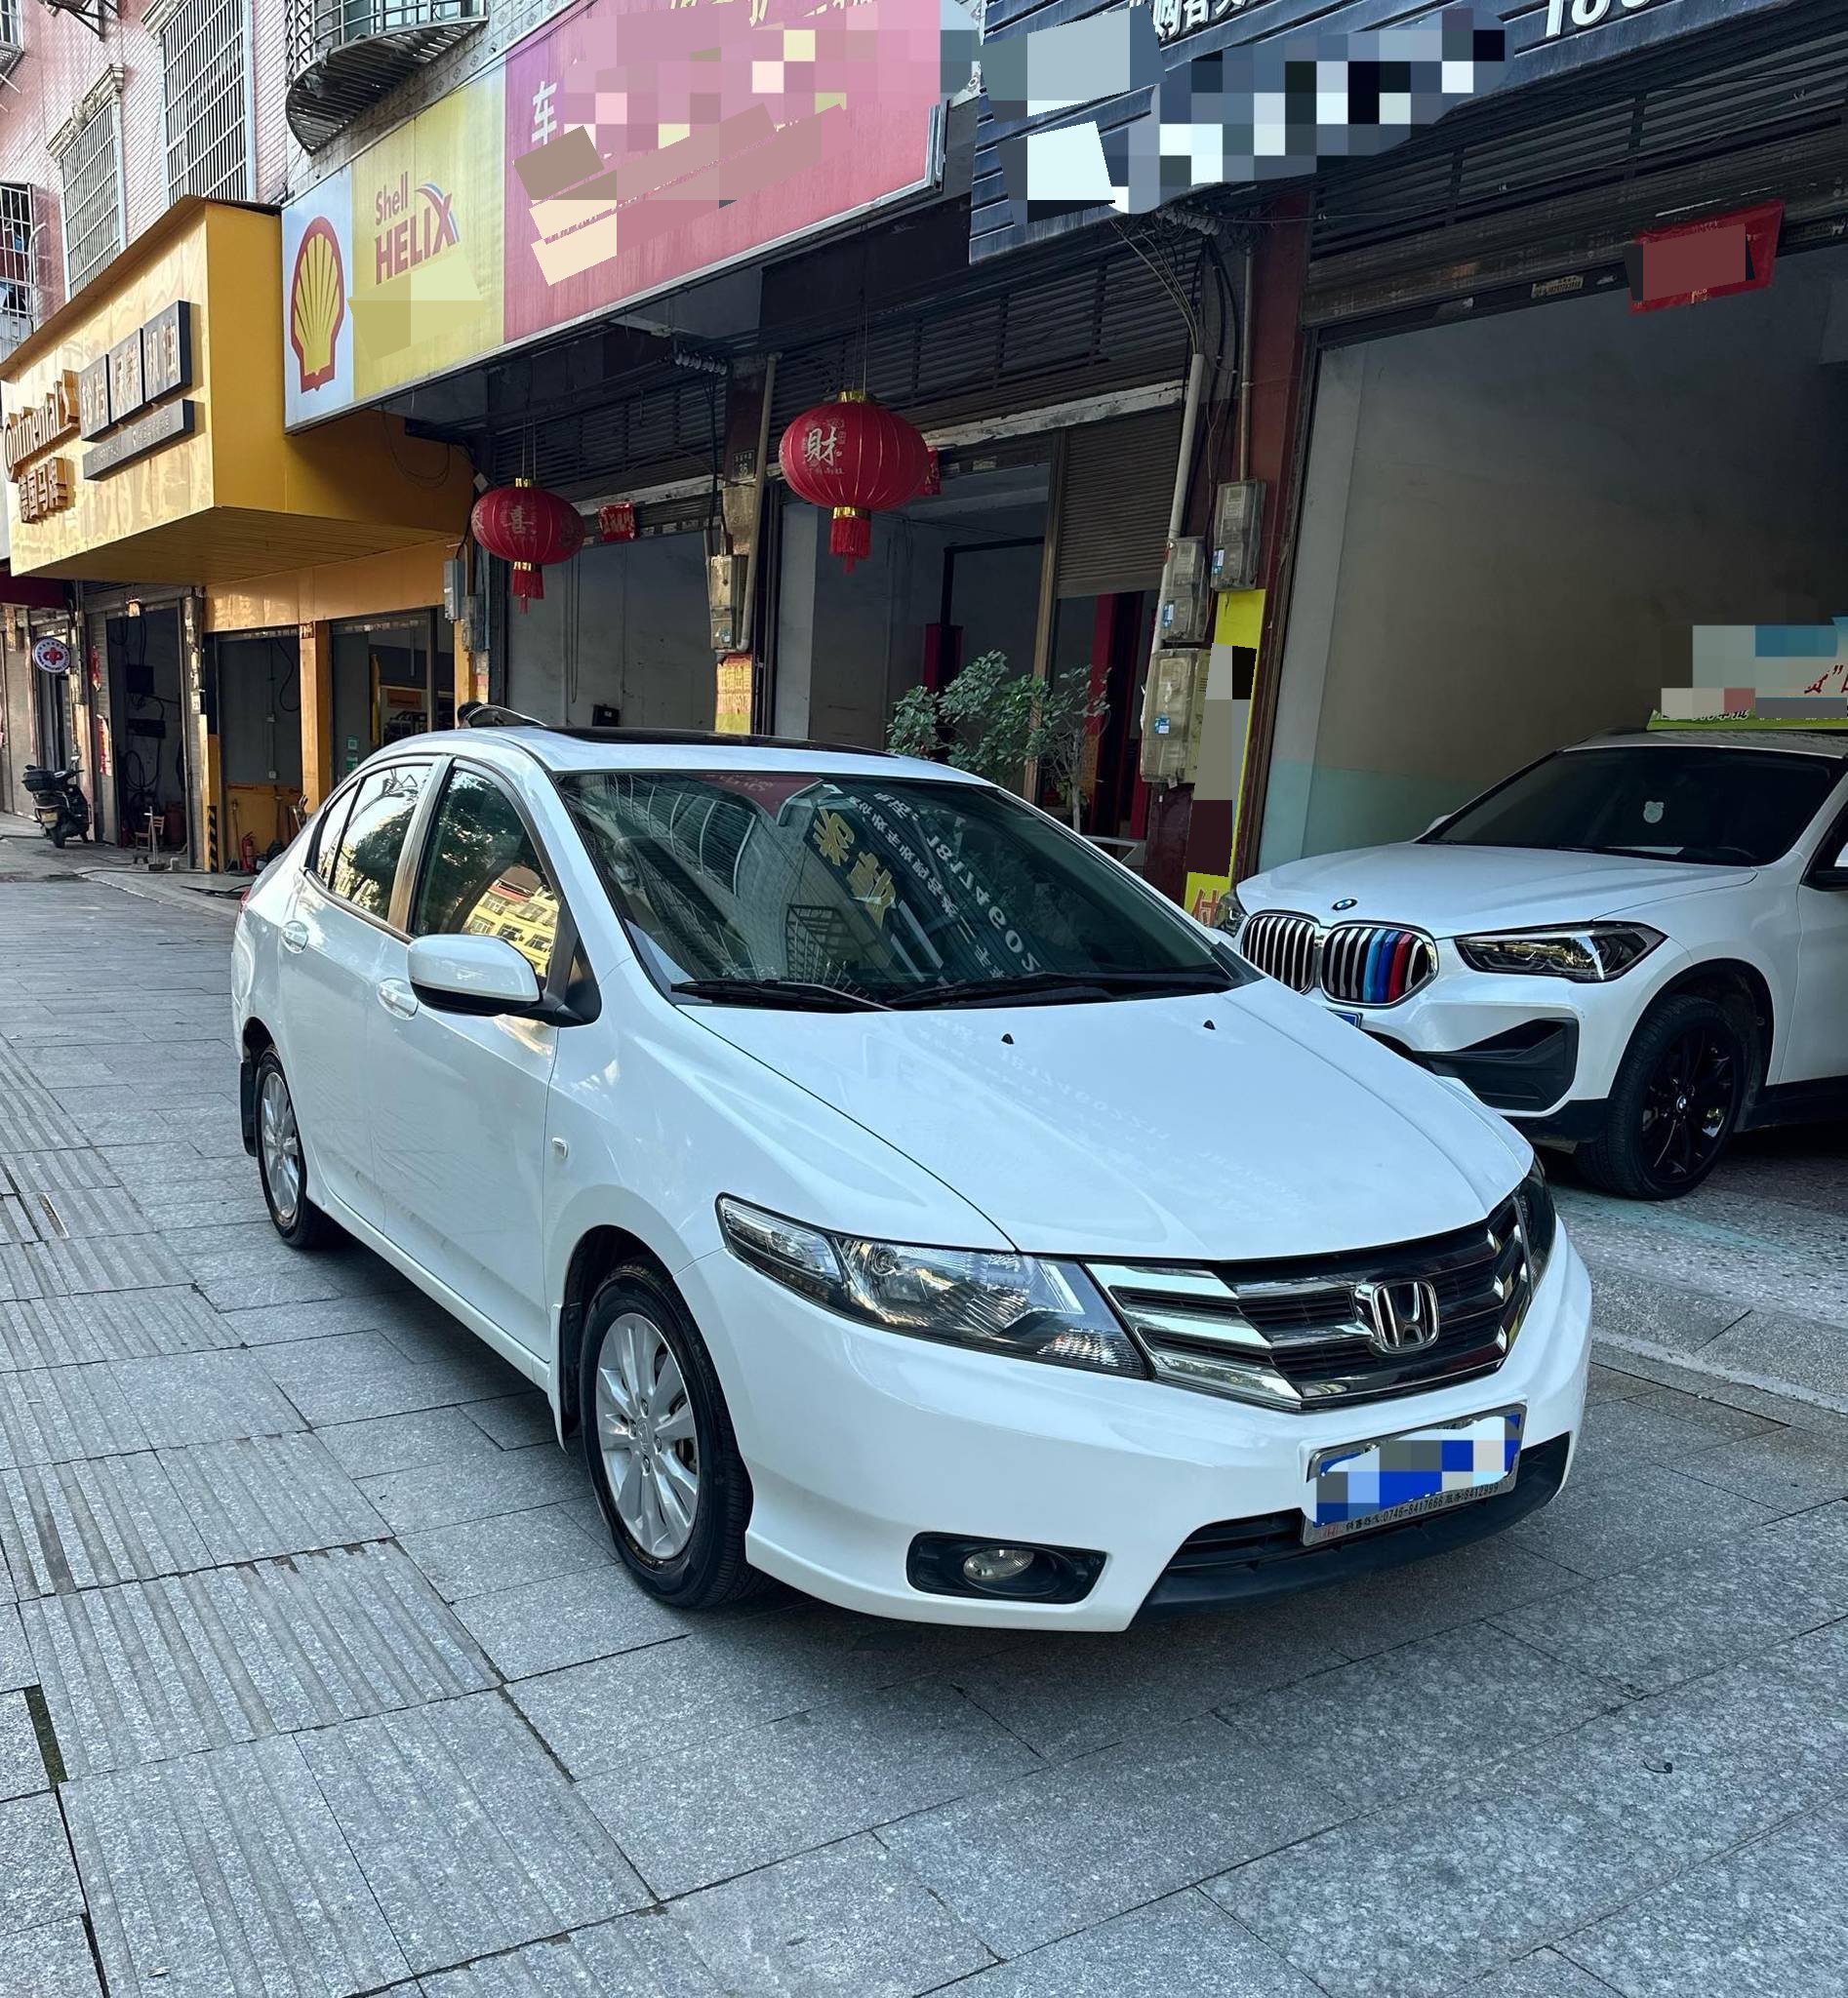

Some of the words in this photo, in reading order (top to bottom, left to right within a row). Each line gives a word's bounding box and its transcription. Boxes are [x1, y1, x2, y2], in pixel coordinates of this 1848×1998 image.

[375, 172, 409, 225] Shell
[375, 191, 458, 286] HELIX
[804, 425, 839, 467] 財
